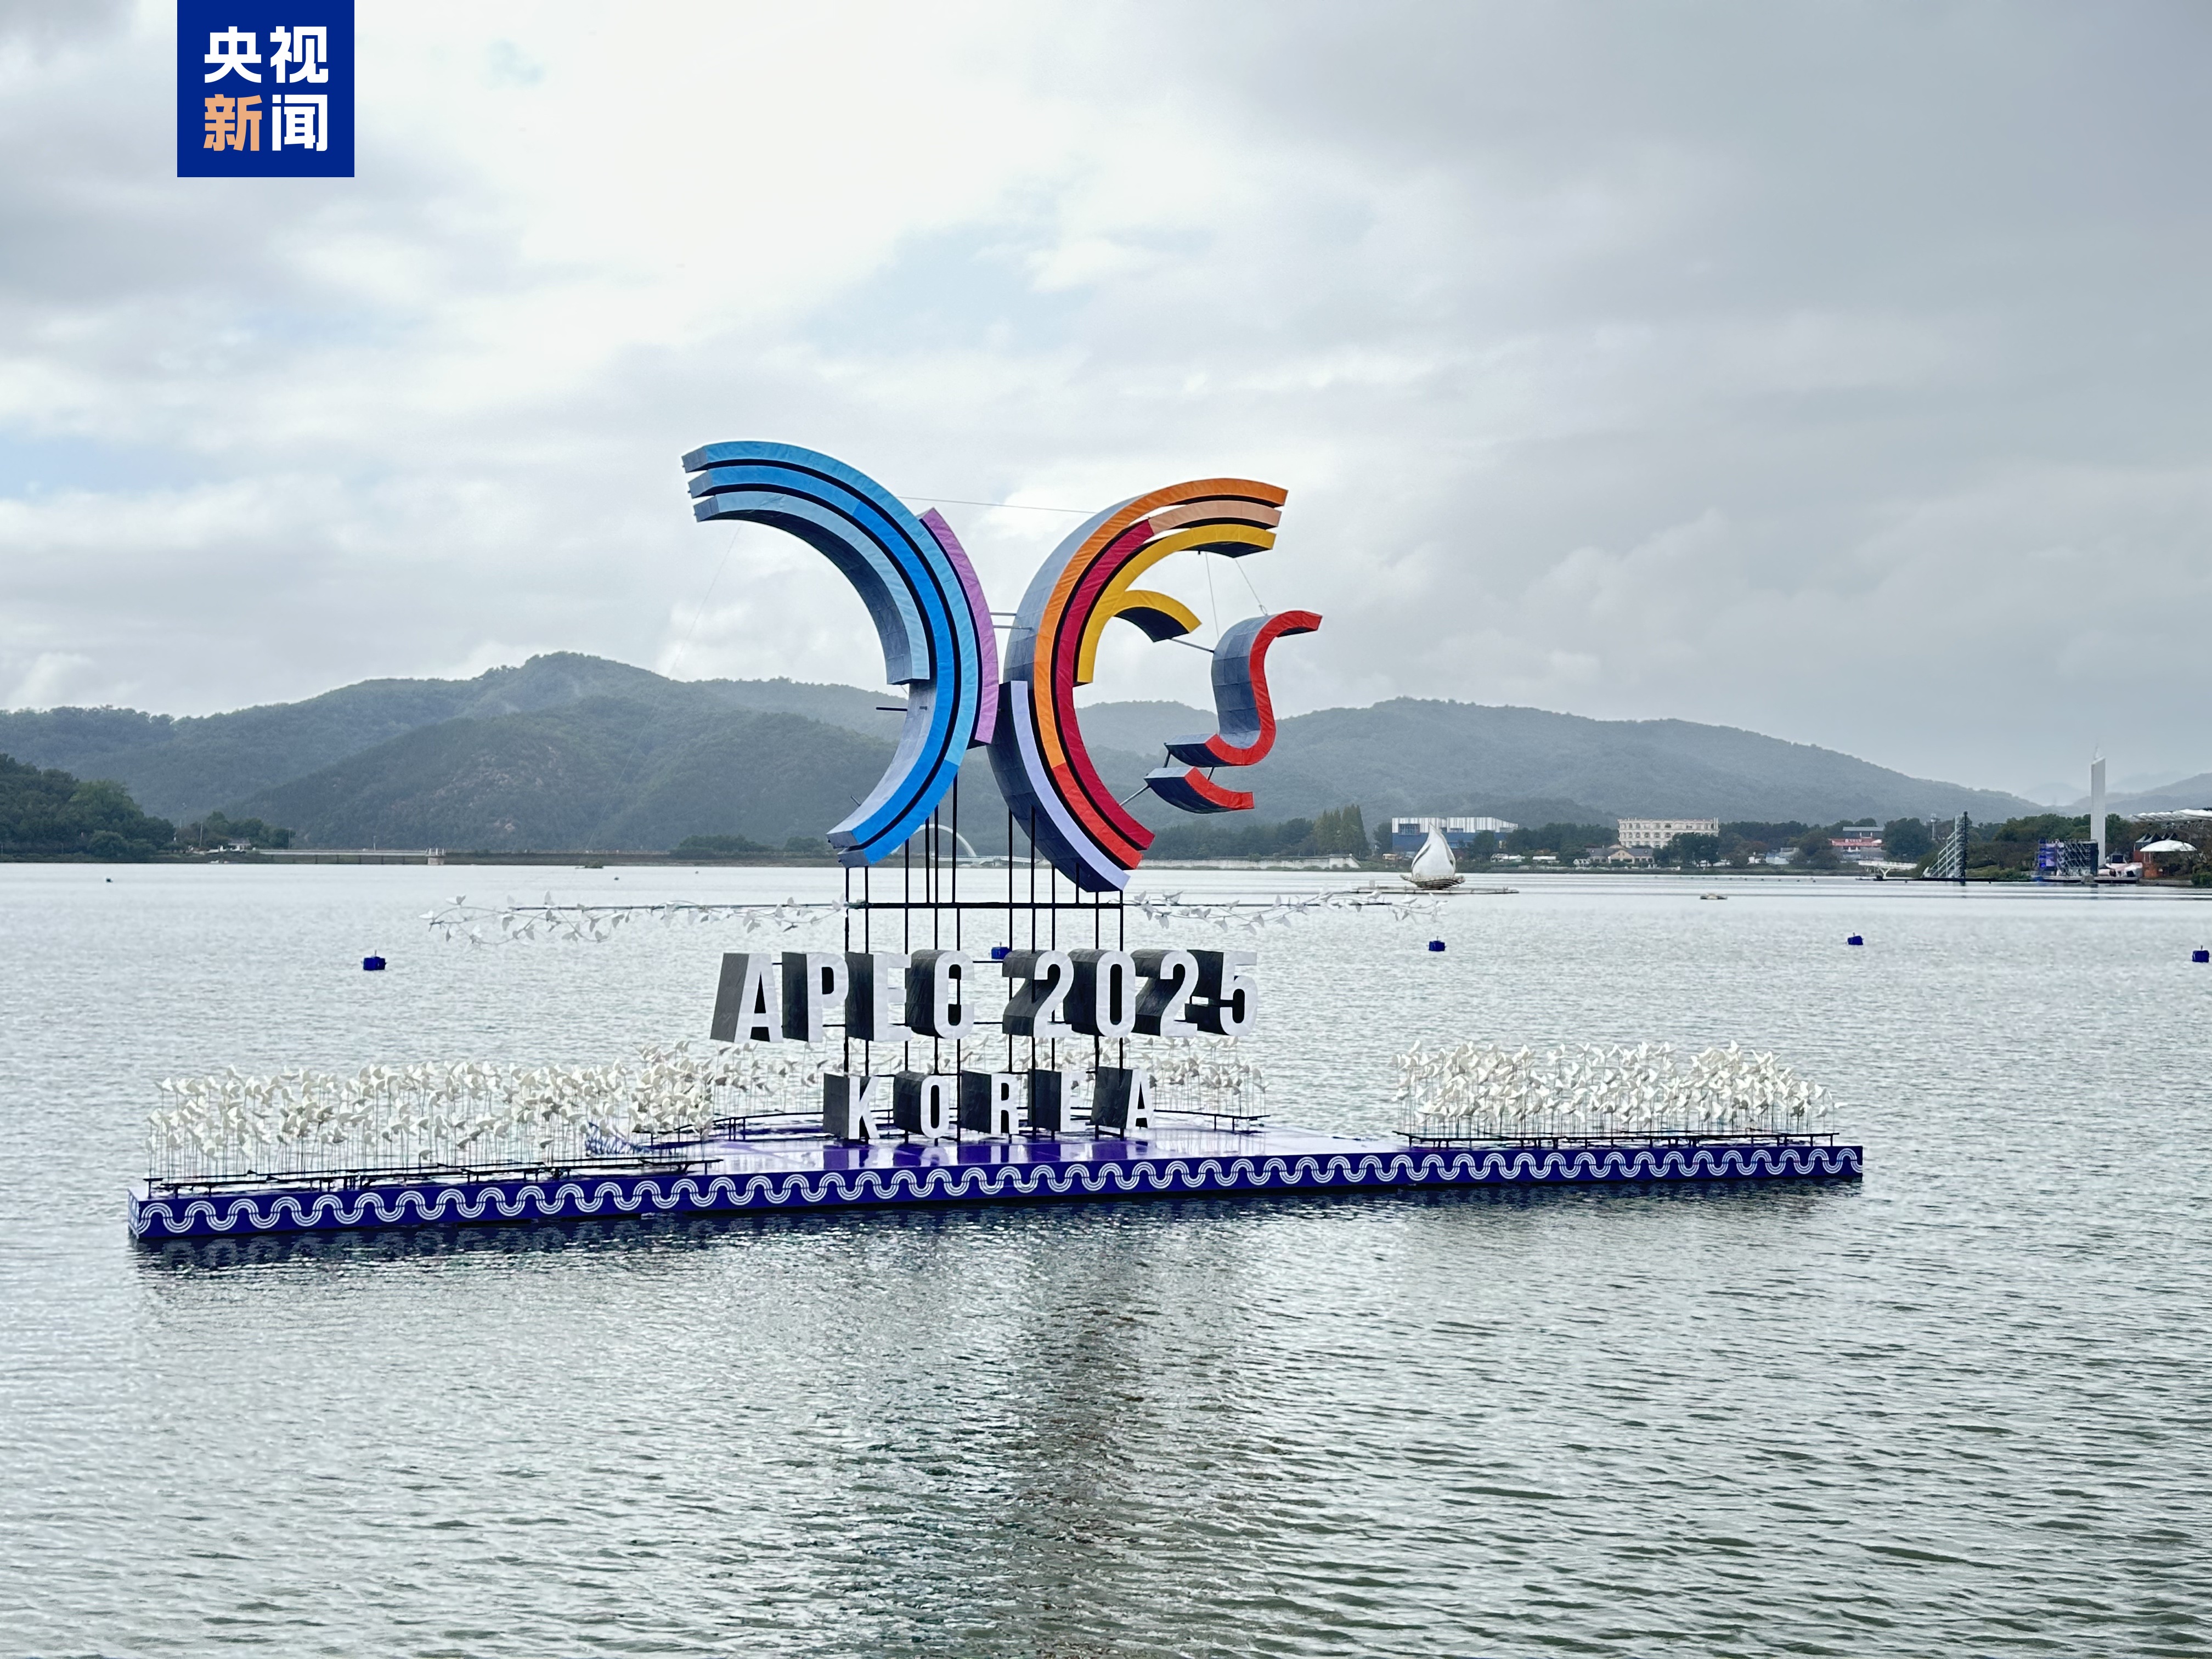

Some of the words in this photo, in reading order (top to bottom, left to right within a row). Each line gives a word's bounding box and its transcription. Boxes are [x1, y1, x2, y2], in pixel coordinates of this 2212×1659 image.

[733, 950, 975, 1043] APEC
[1033, 950, 1258, 1038] 2025
[848, 1068, 1154, 1140] KOREA
